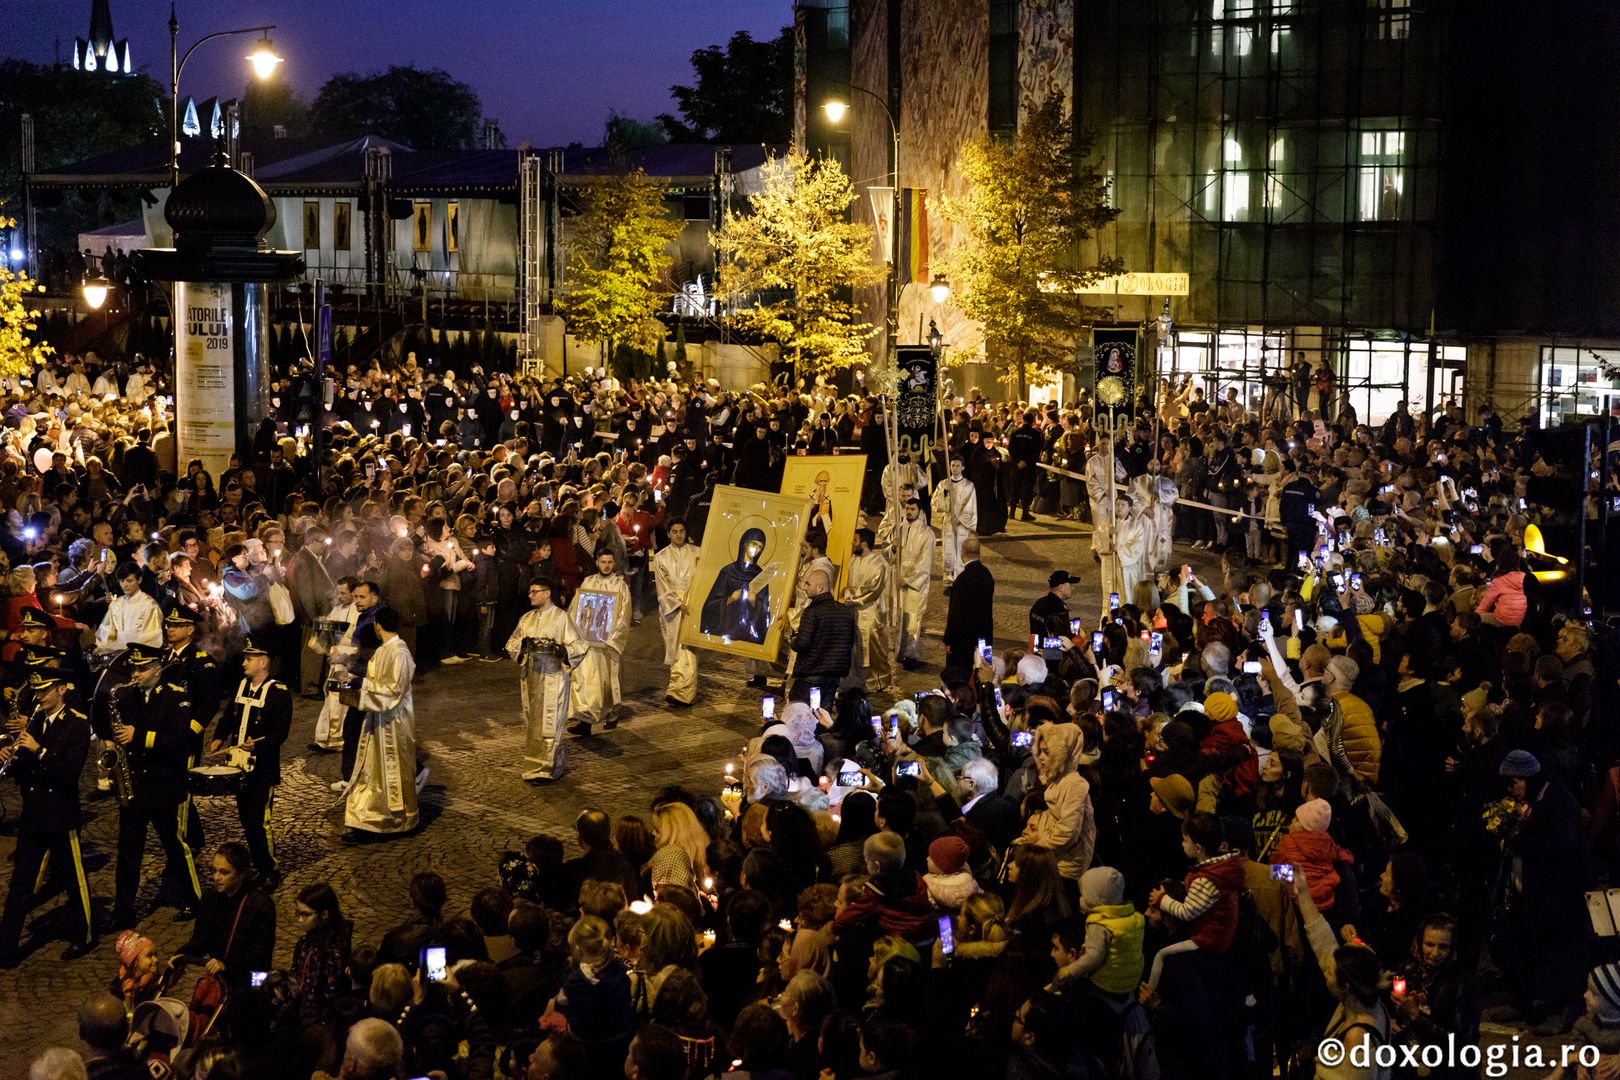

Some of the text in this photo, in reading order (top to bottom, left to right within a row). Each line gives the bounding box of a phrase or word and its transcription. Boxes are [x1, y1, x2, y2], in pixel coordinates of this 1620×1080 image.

[187, 304, 228, 322] ĂTORILE
[186, 322, 228, 336] ULUI
[206, 337, 229, 350] 2019
